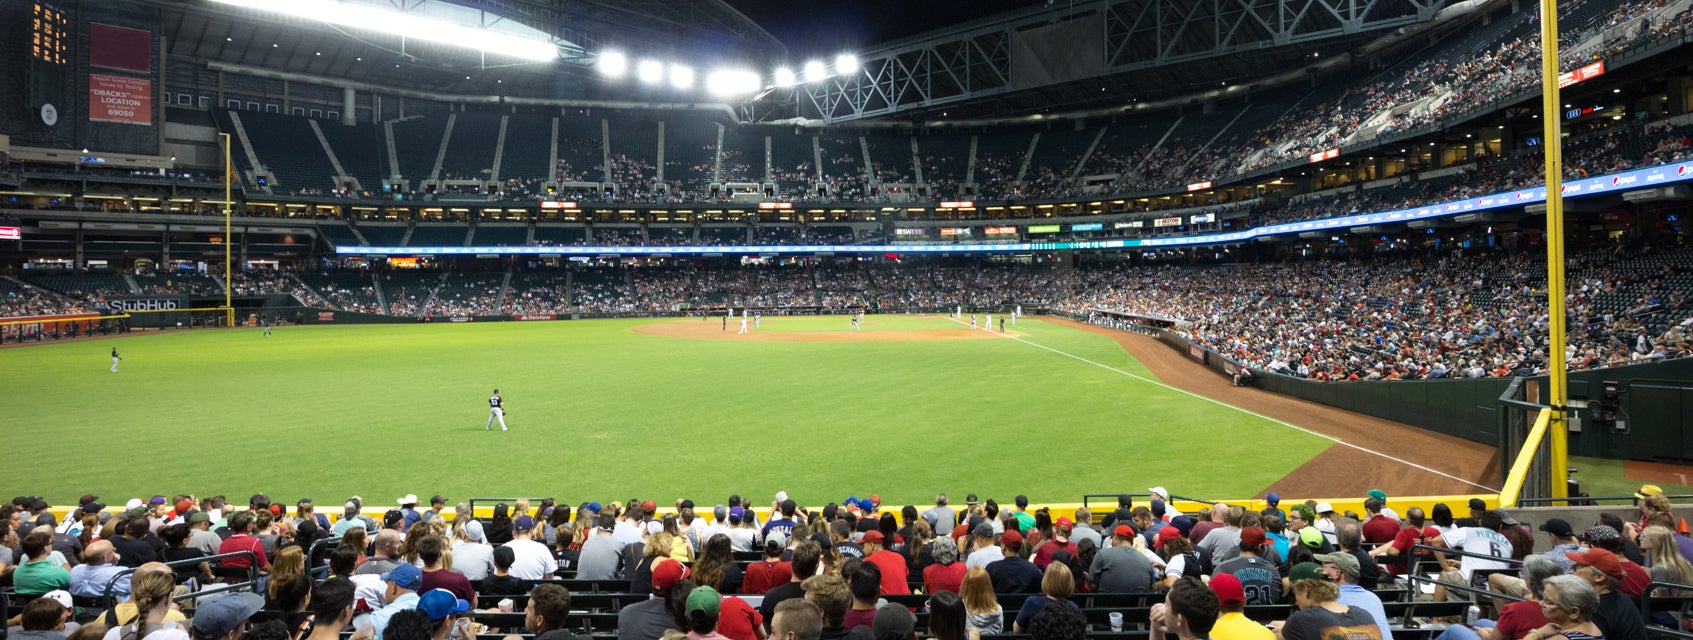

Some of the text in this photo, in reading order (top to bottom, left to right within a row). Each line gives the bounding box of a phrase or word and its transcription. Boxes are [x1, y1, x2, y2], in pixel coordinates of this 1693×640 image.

[101, 97, 141, 107] LOCATION
[108, 109, 134, 117] 69050
[111, 300, 176, 311] StubHub
[1475, 529, 1509, 546] PERALTA
[1489, 541, 1502, 558] 6
[557, 559, 571, 569] TON
[1244, 584, 1272, 606] 21
